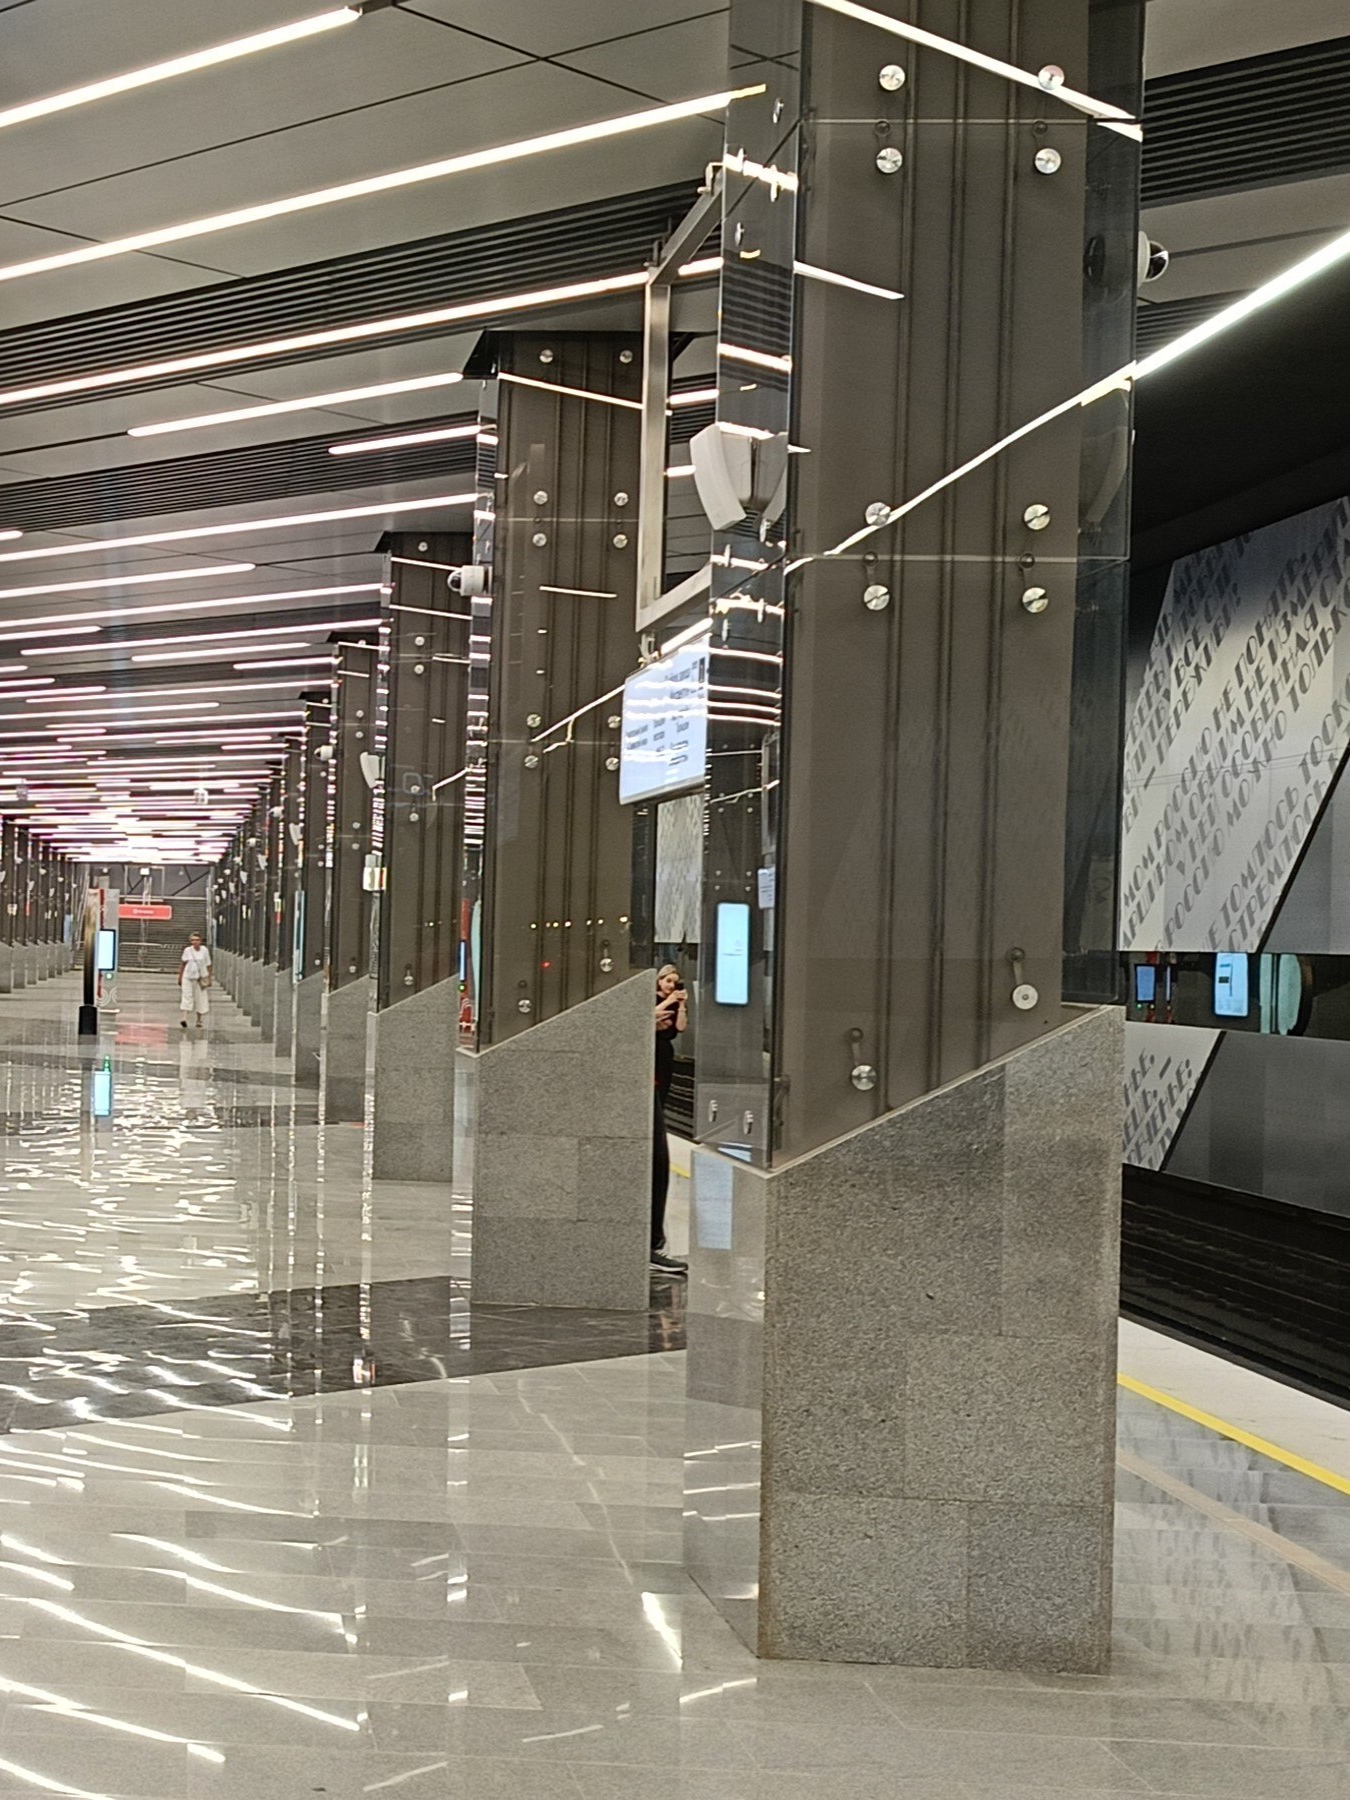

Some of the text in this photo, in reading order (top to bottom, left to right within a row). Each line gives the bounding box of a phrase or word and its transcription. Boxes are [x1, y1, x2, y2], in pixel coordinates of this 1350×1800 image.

[1154, 727, 1212, 851] РОССИЮ
[1213, 679, 1237, 733] НЕ
[1163, 827, 1226, 949] РОССИЮ
